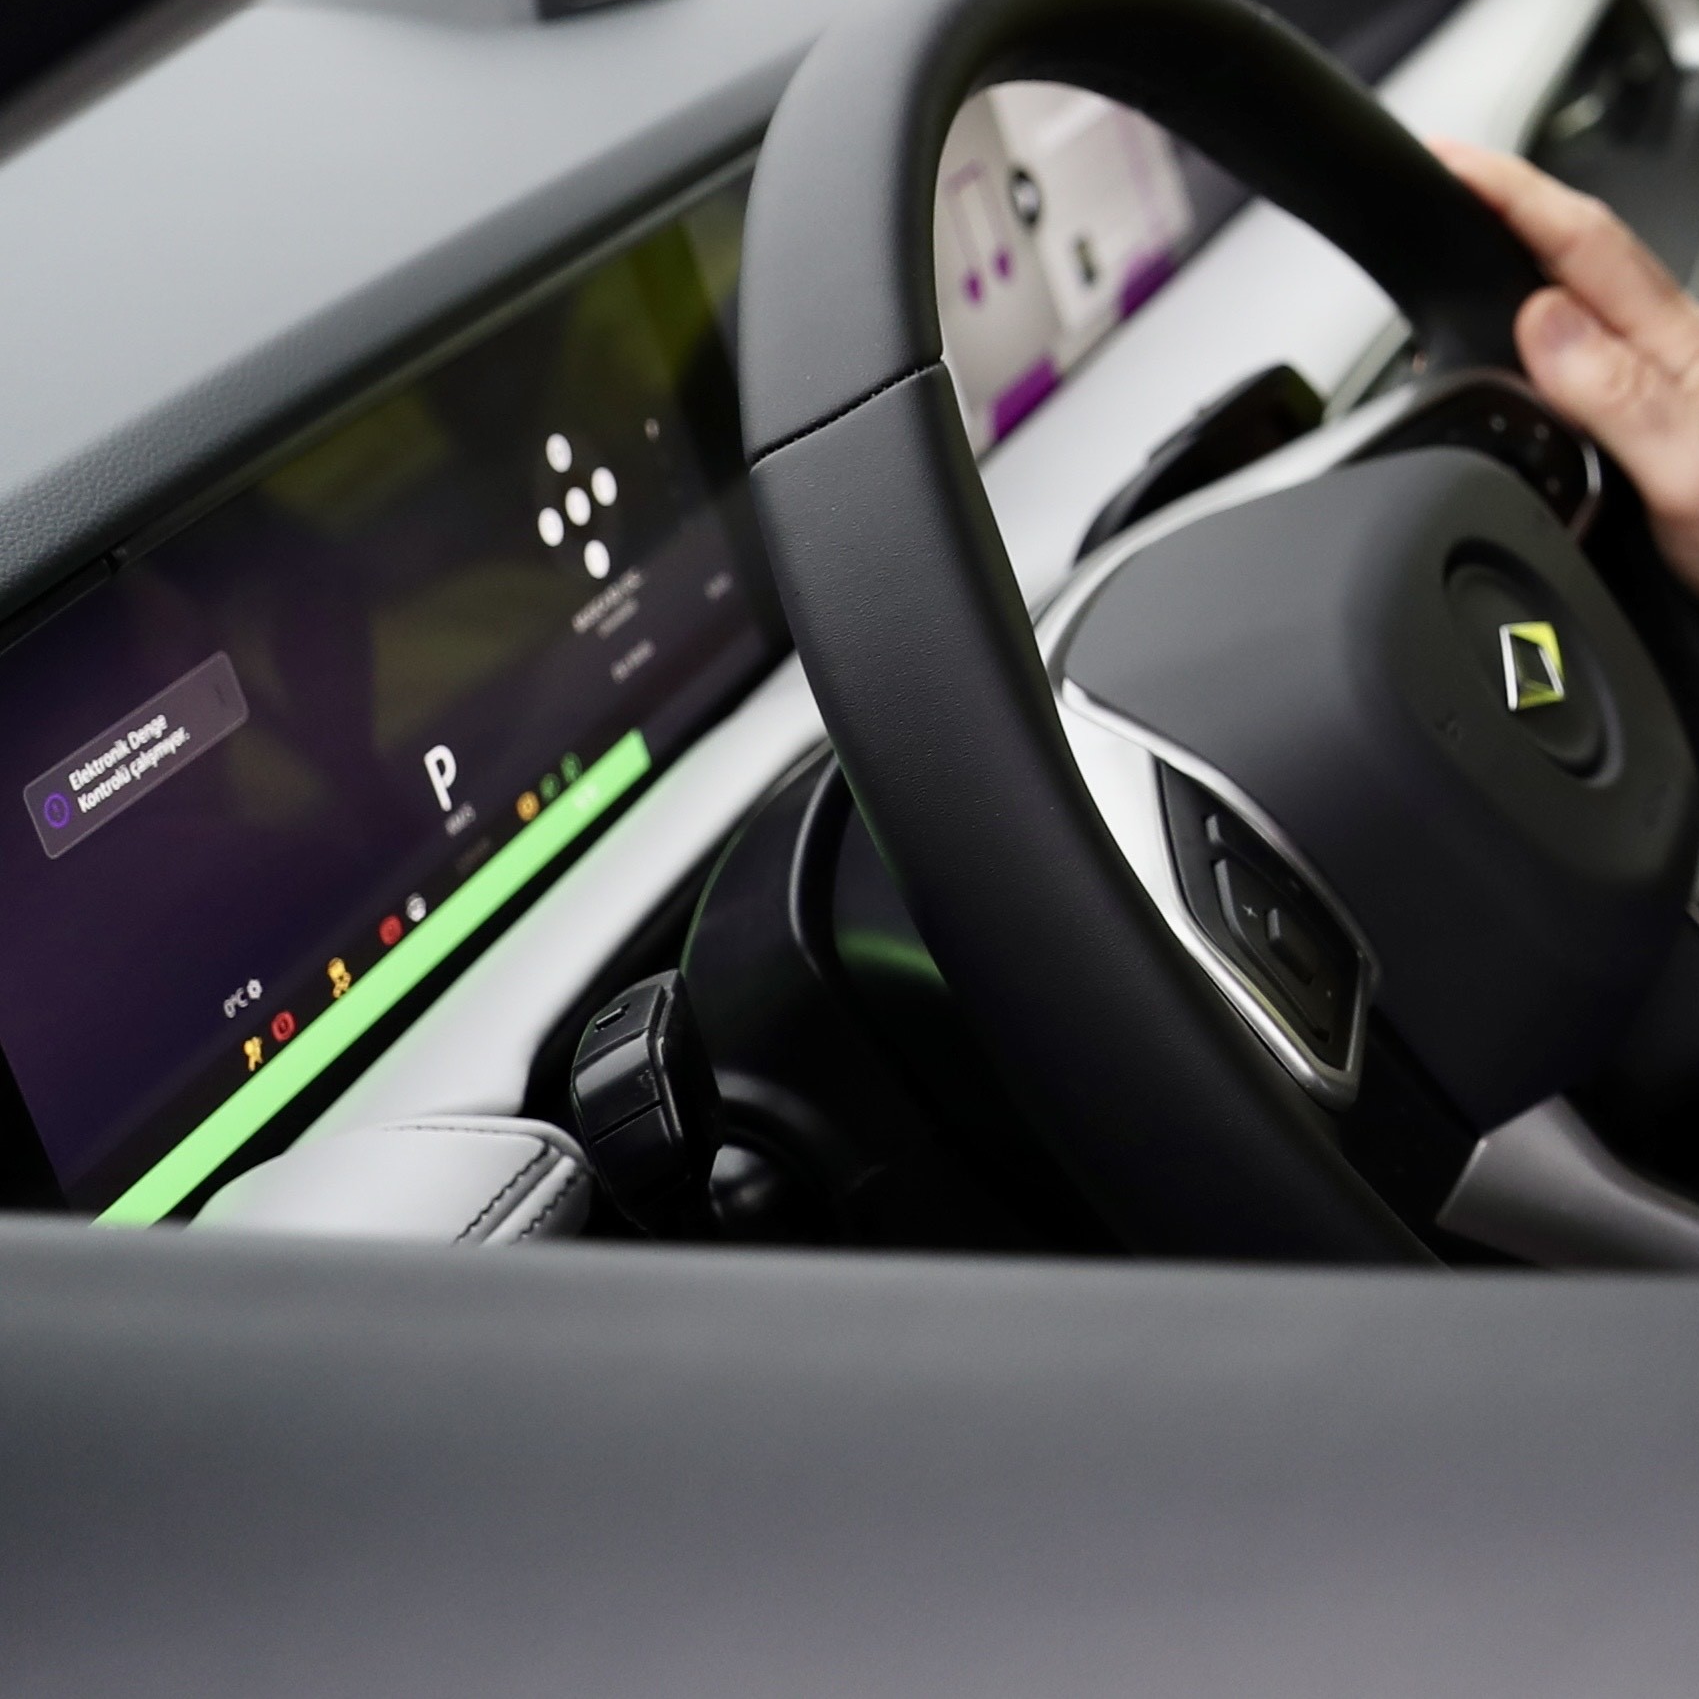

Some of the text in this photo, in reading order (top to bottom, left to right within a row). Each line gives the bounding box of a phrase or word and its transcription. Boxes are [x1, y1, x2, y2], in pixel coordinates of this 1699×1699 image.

[69, 714, 167, 791] Elektronik Denge
[424, 744, 457, 812] P
[77, 764, 132, 813] Kontrolü
